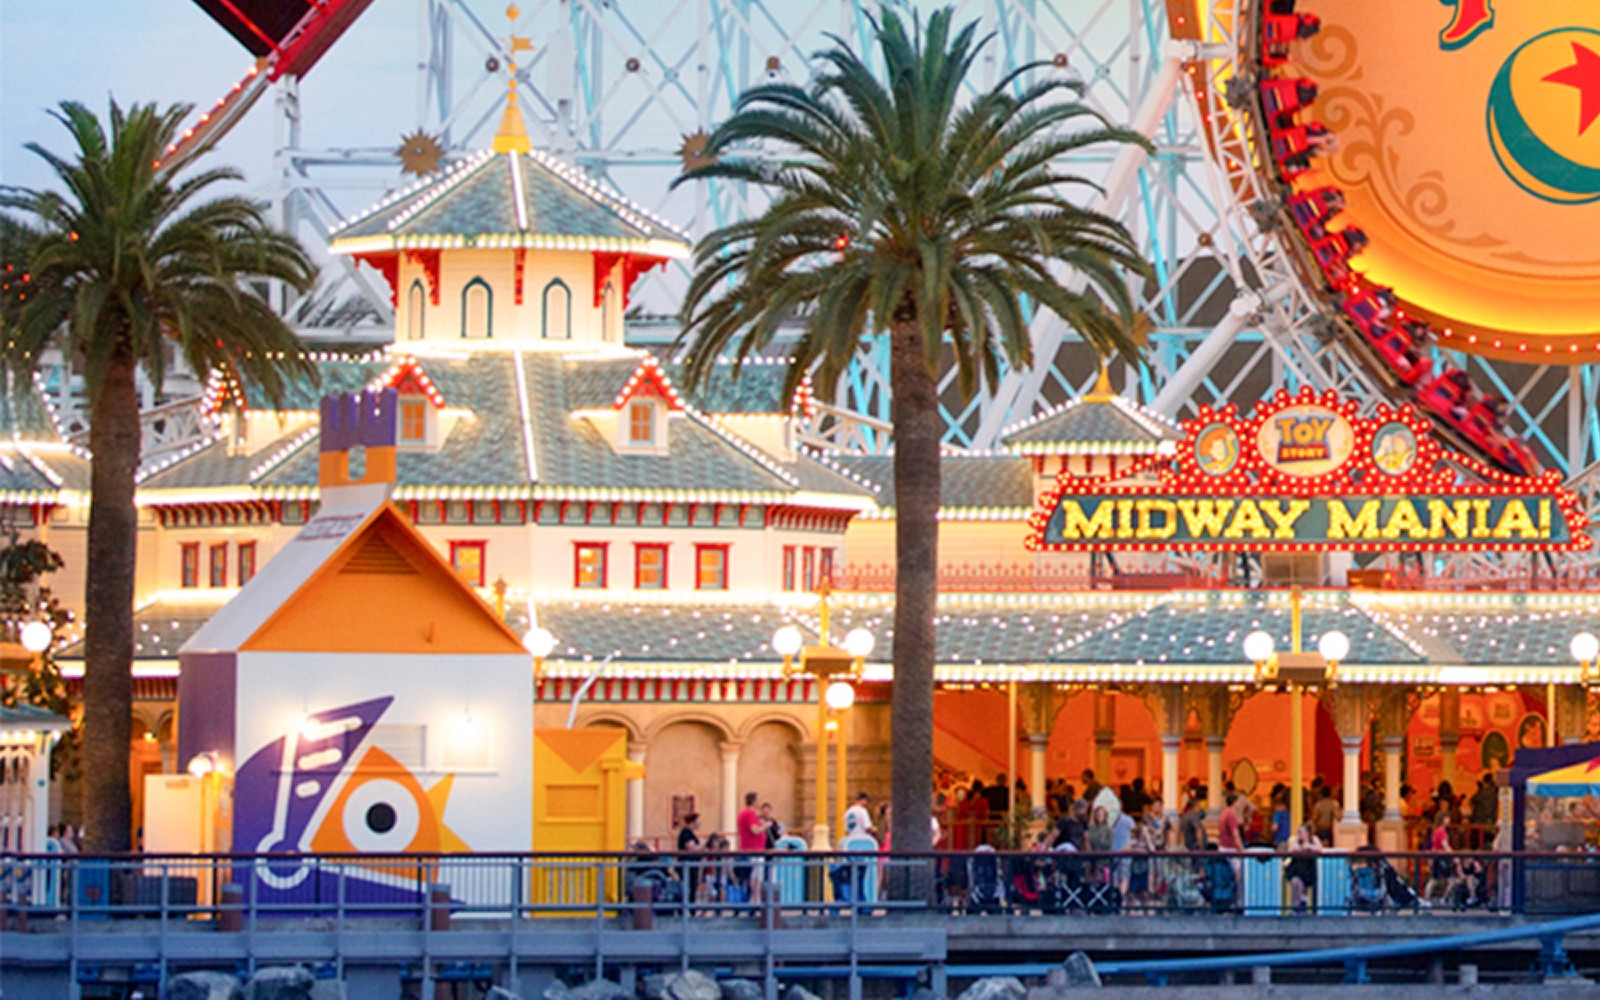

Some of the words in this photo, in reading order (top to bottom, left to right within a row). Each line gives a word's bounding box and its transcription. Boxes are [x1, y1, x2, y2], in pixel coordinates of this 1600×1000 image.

[1275, 416, 1334, 446] TOY
[1061, 499, 1310, 540] MIDWAY
[1326, 499, 1552, 540] MANIA!
